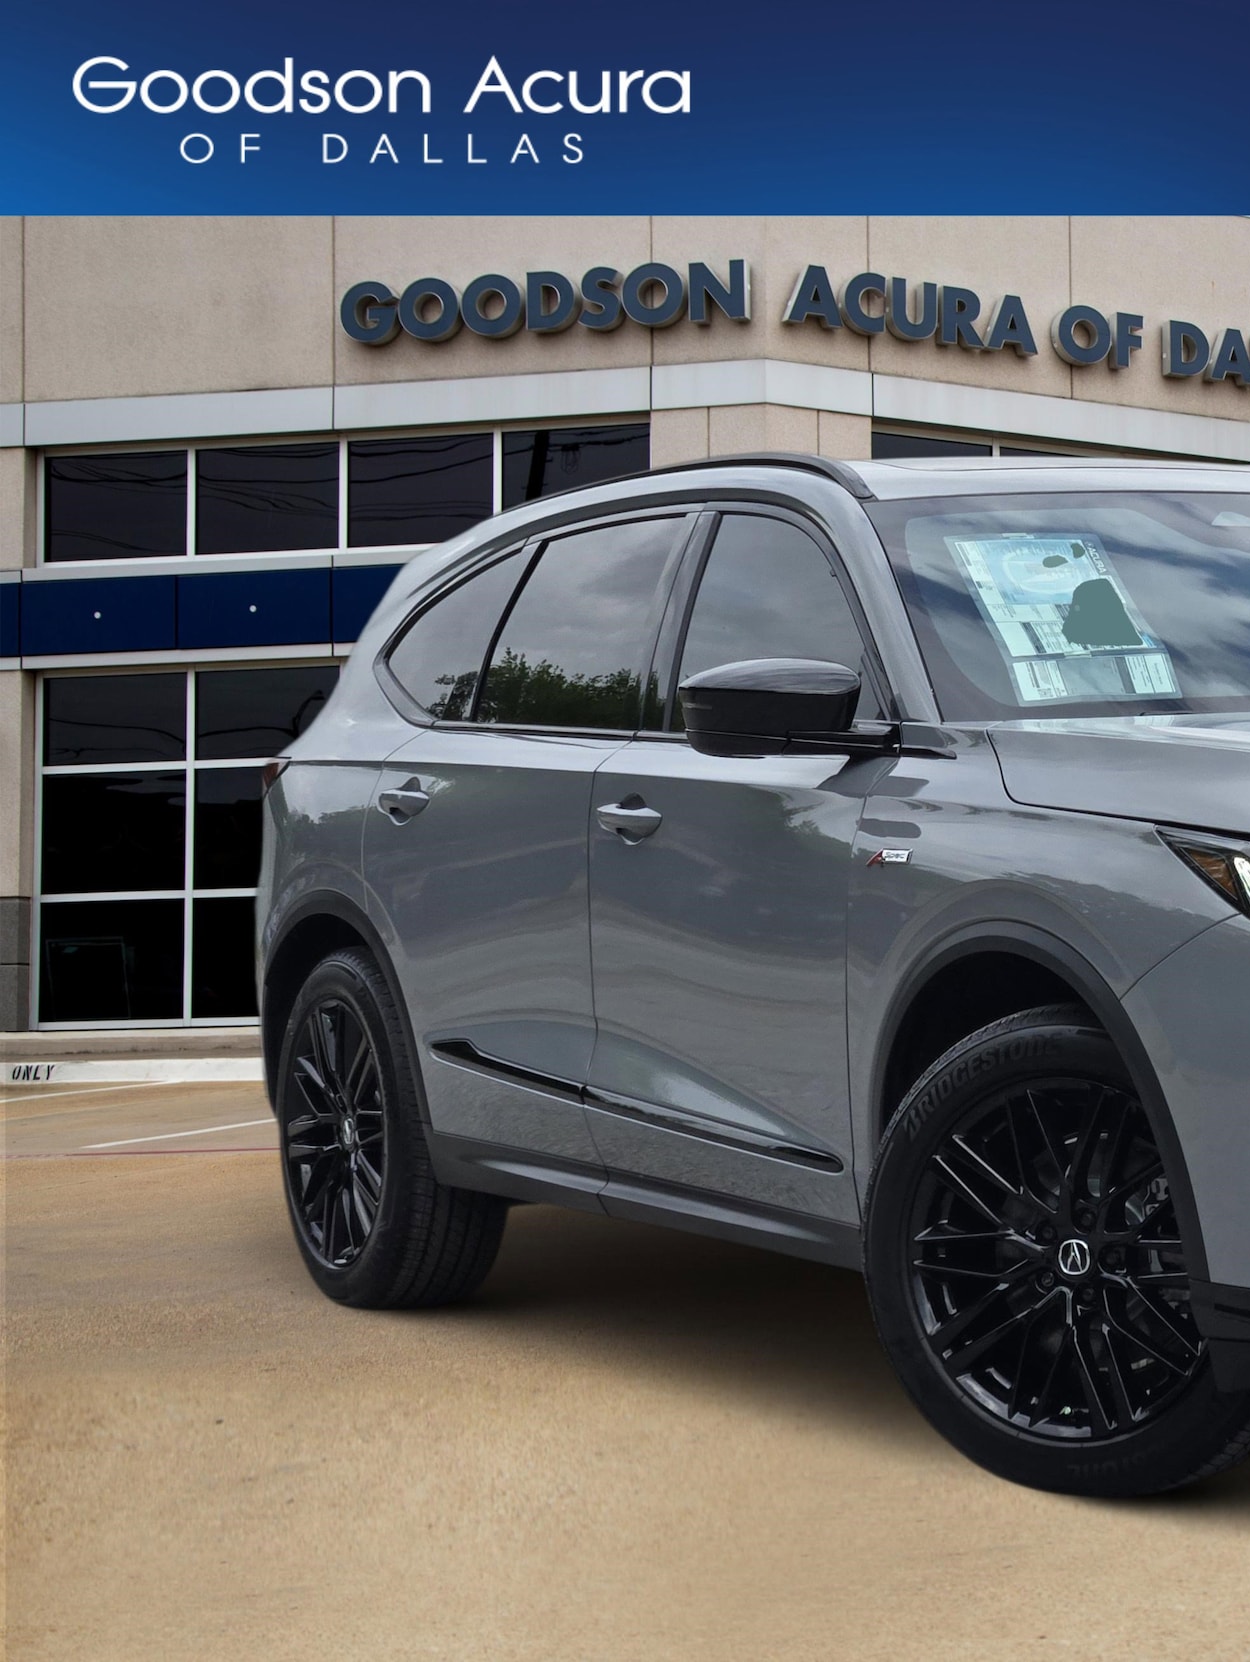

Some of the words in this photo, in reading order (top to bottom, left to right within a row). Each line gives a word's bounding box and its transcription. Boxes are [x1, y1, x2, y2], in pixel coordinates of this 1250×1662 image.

[340, 258, 752, 347] GOODSON
[783, 264, 1038, 356] ACURA
[1052, 304, 1144, 369] OF
[1087, 546, 1108, 574] ACURA
[11, 1064, 56, 1081] ONLY
[902, 1033, 1062, 1142] BRIDGESTONE
